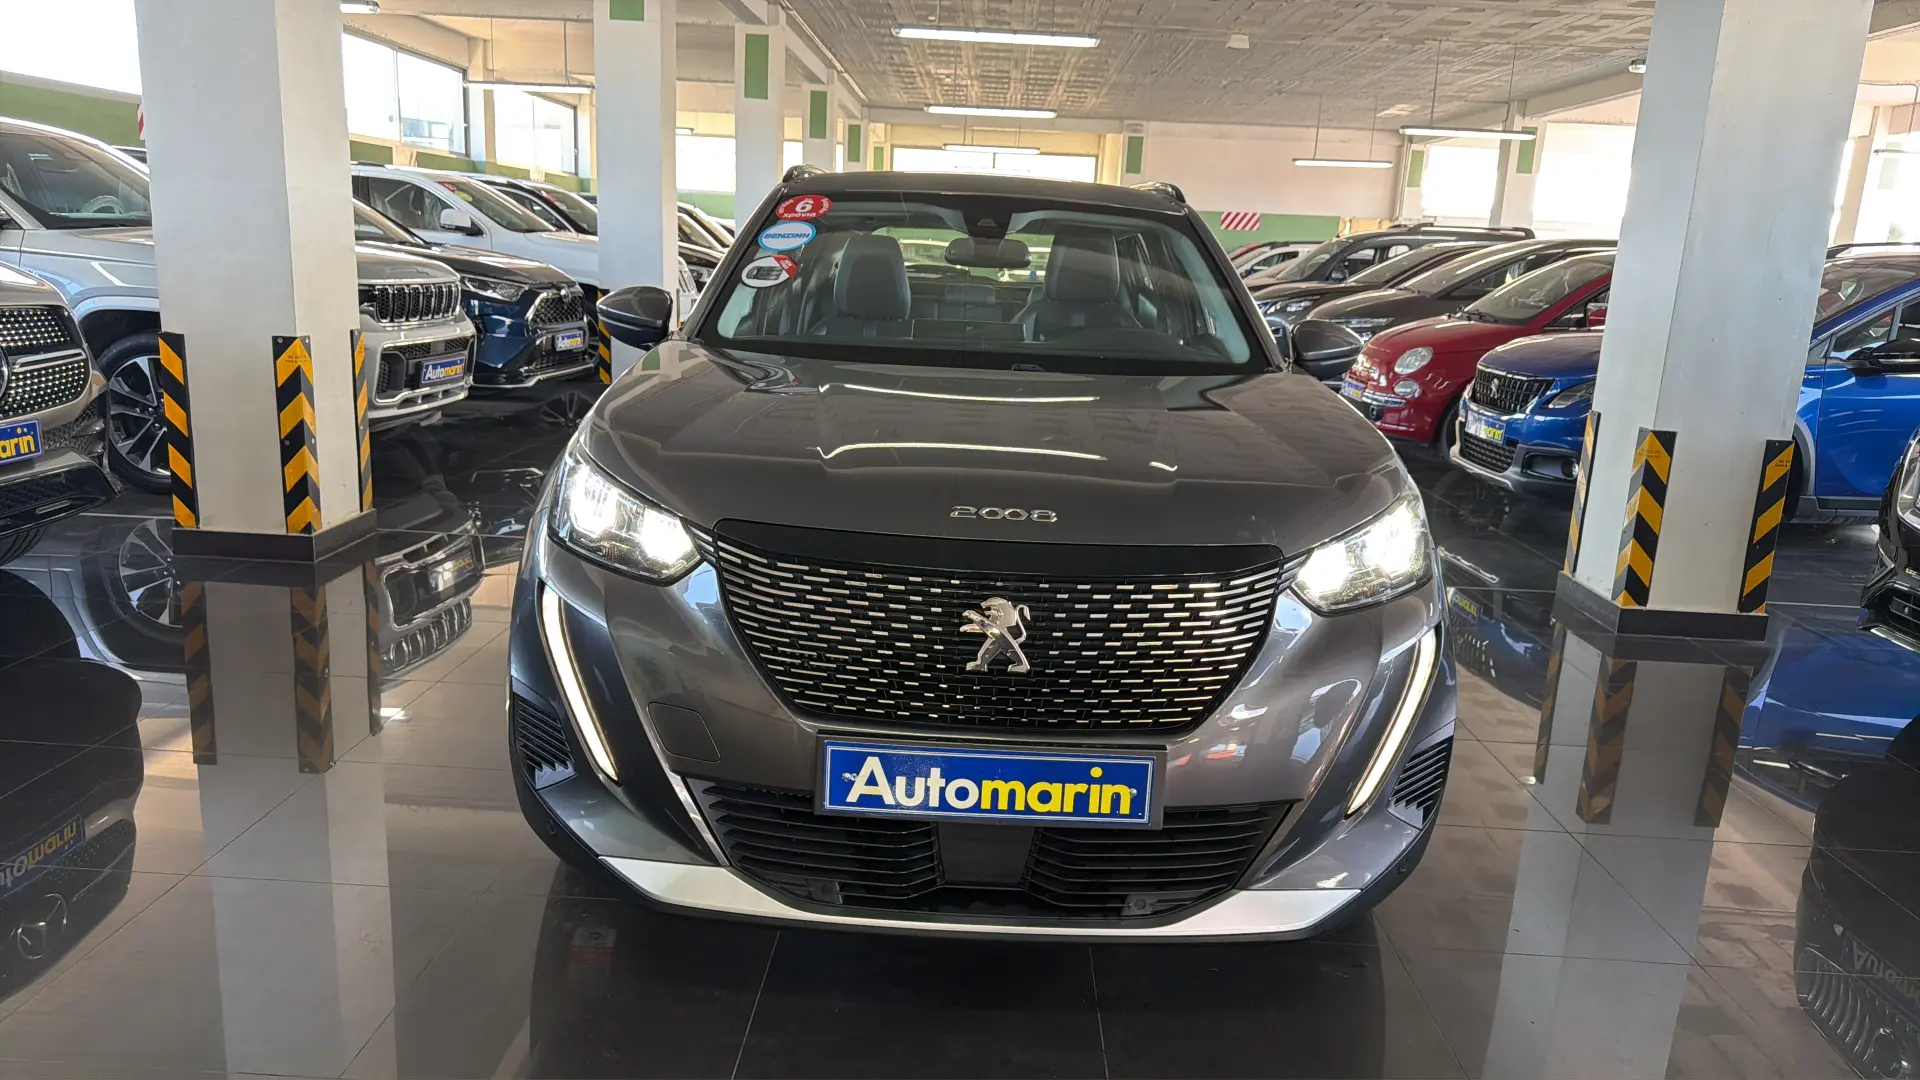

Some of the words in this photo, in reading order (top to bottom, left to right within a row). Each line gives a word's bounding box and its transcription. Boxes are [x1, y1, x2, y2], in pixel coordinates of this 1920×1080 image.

[795, 199, 815, 213] 6
[425, 360, 463, 381] Automarin
[949, 505, 1058, 523] 2008
[845, 756, 1131, 815] Automarin
